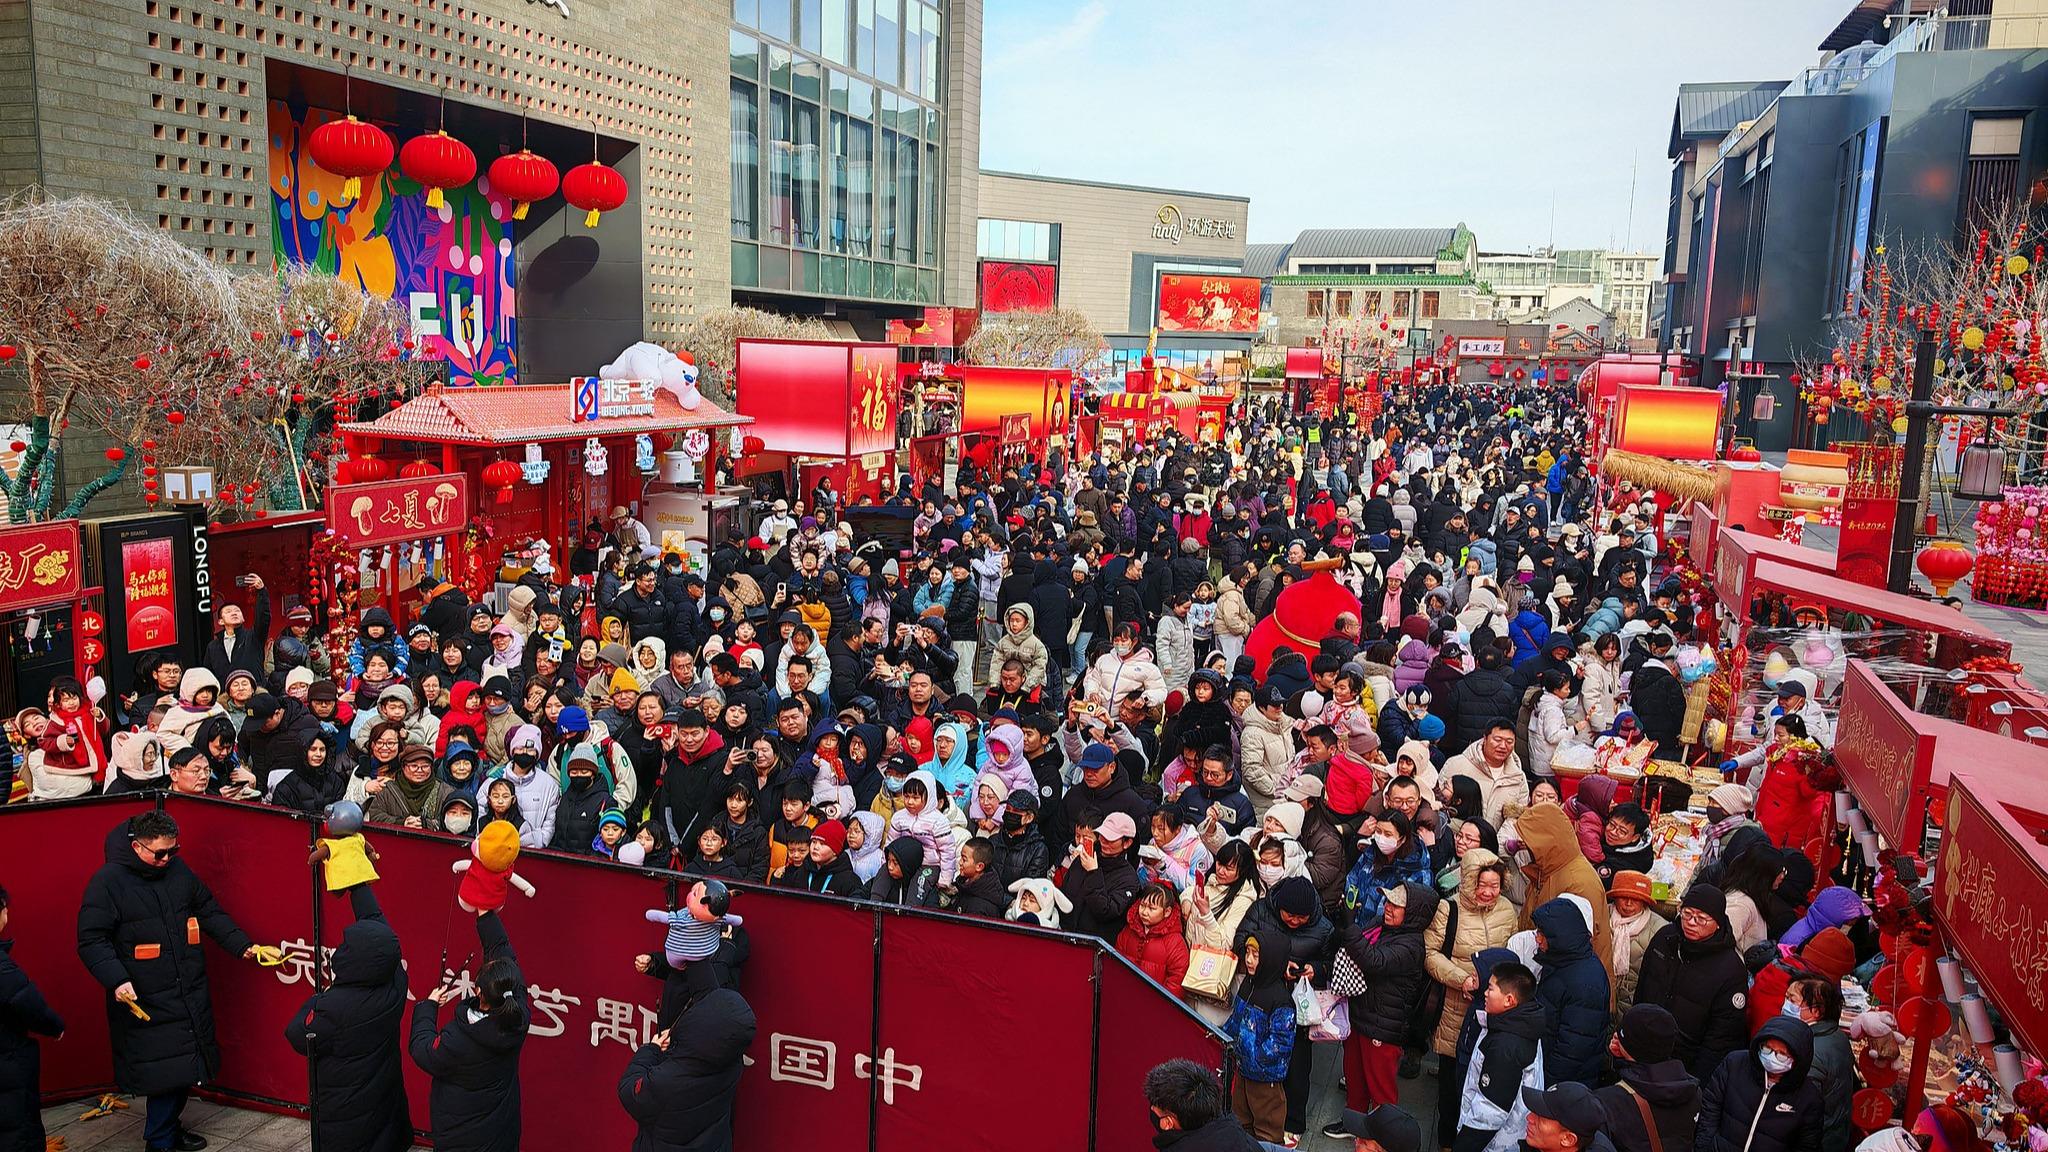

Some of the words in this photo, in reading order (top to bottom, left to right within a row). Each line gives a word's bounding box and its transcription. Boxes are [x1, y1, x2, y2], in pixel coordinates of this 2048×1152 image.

[1186, 217, 1236, 239] 环游天地
[409, 292, 483, 358] FU
[1462, 343, 1501, 352] 手工皮艺
[602, 379, 655, 402] 北京一轻
[861, 363, 887, 432] 福
[193, 526, 211, 613] LONGFU
[82, 617, 101, 660] 北京
